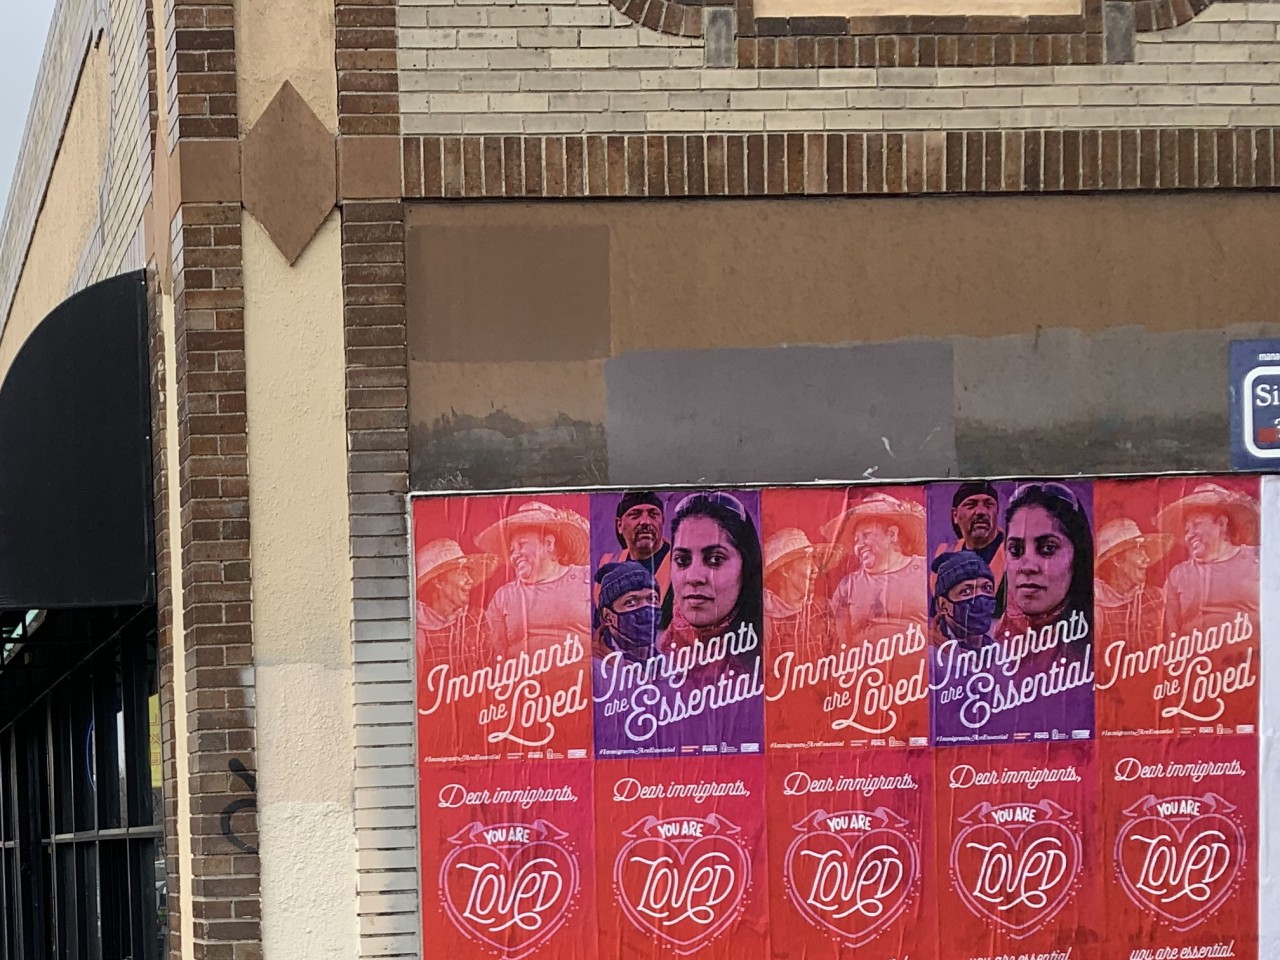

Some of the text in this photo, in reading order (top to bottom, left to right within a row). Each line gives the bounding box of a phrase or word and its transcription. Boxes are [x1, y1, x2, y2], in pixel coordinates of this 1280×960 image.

[593, 621, 759, 703] Immigrants
[766, 623, 926, 702] Immigrants
[929, 610, 1089, 690] Immigrants
[1094, 612, 1252, 691] Immigrants
[419, 633, 585, 715] Immigrants
[940, 645, 1094, 728] are Essential
[1153, 647, 1256, 721] are Loved
[479, 670, 587, 746] are Loved
[604, 656, 764, 741] are Essential
[823, 659, 928, 734] are Loved
[949, 764, 1081, 789] Dear immigrants,
[1115, 757, 1246, 782] Dear immigrants,
[438, 782, 578, 809] Dear immigrants,
[613, 778, 750, 803] Dear immigrants,
[784, 771, 918, 797] Dear immigrants,
[992, 807, 1037, 824] YOU ARE
[1157, 801, 1200, 818] YOU ARE
[483, 827, 530, 846] YOU ARE
[657, 822, 704, 840] YOU ARE
[826, 815, 872, 832] YOU ARE
[1156, 946, 1178, 960] are
[1180, 940, 1235, 959] essential.
